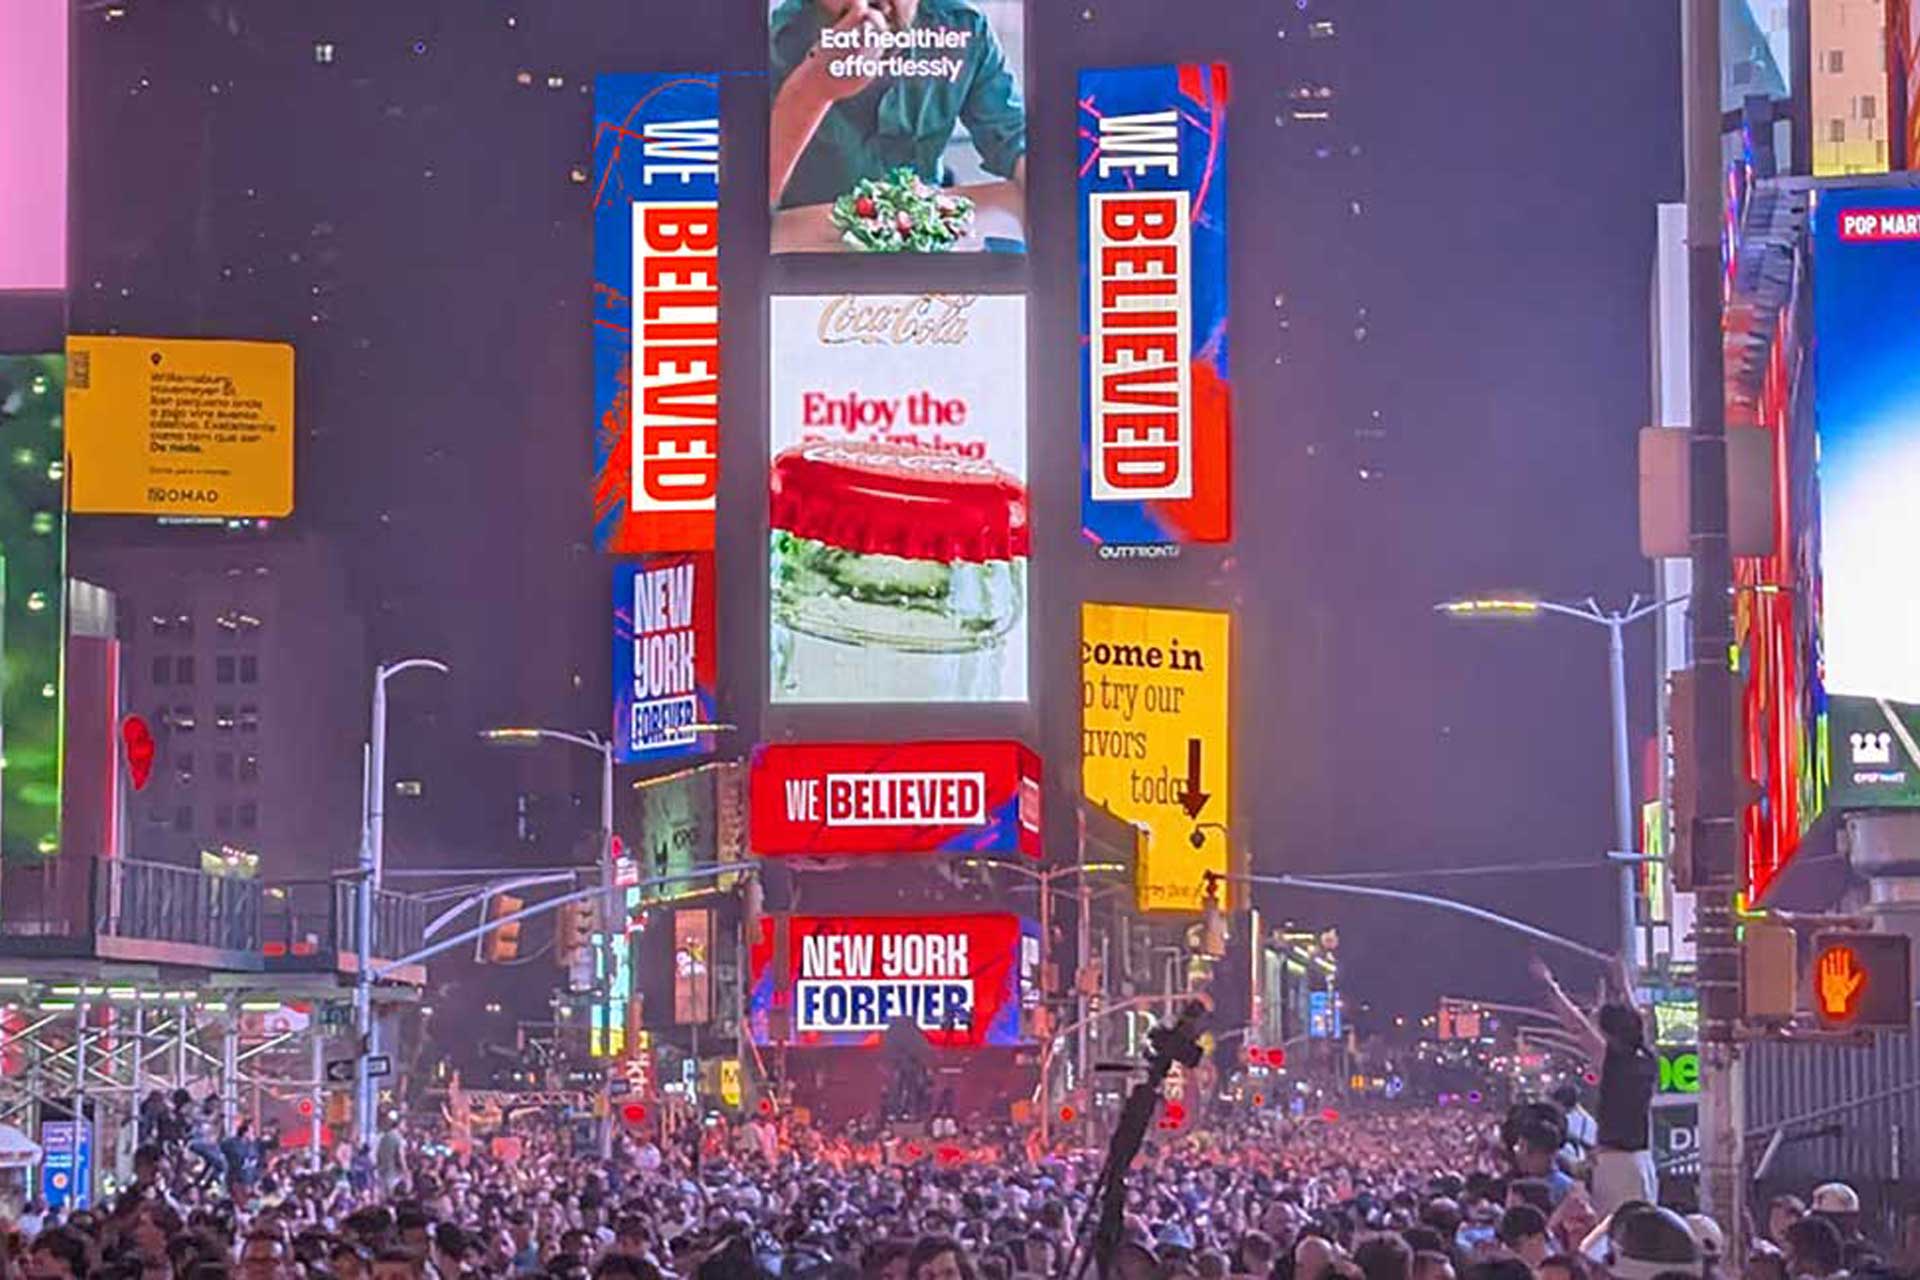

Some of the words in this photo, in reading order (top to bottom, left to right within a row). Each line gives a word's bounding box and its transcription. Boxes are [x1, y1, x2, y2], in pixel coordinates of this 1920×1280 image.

[820, 28, 862, 49] Eat
[864, 26, 971, 49] healthier
[829, 55, 964, 82] effortlessly
[643, 119, 719, 185] WE
[1099, 109, 1178, 178] WE
[1844, 215, 1877, 235] POP
[643, 208, 718, 502] BELIEVED
[1102, 199, 1178, 489] BELIEVED
[803, 391, 897, 433] Enjoy
[907, 390, 967, 426] the
[634, 563, 695, 634] NEW
[634, 630, 695, 699] YORK
[1169, 638, 1204, 671] in
[1101, 674, 1138, 720] try
[1144, 684, 1185, 713] our
[632, 699, 695, 746] FOREVER
[785, 779, 820, 822] WE
[830, 779, 980, 819] BELIEVED
[1131, 767, 1192, 815] toda
[802, 934, 874, 977] NEW
[881, 933, 969, 977] YORK
[803, 984, 970, 1026] FOREVER
